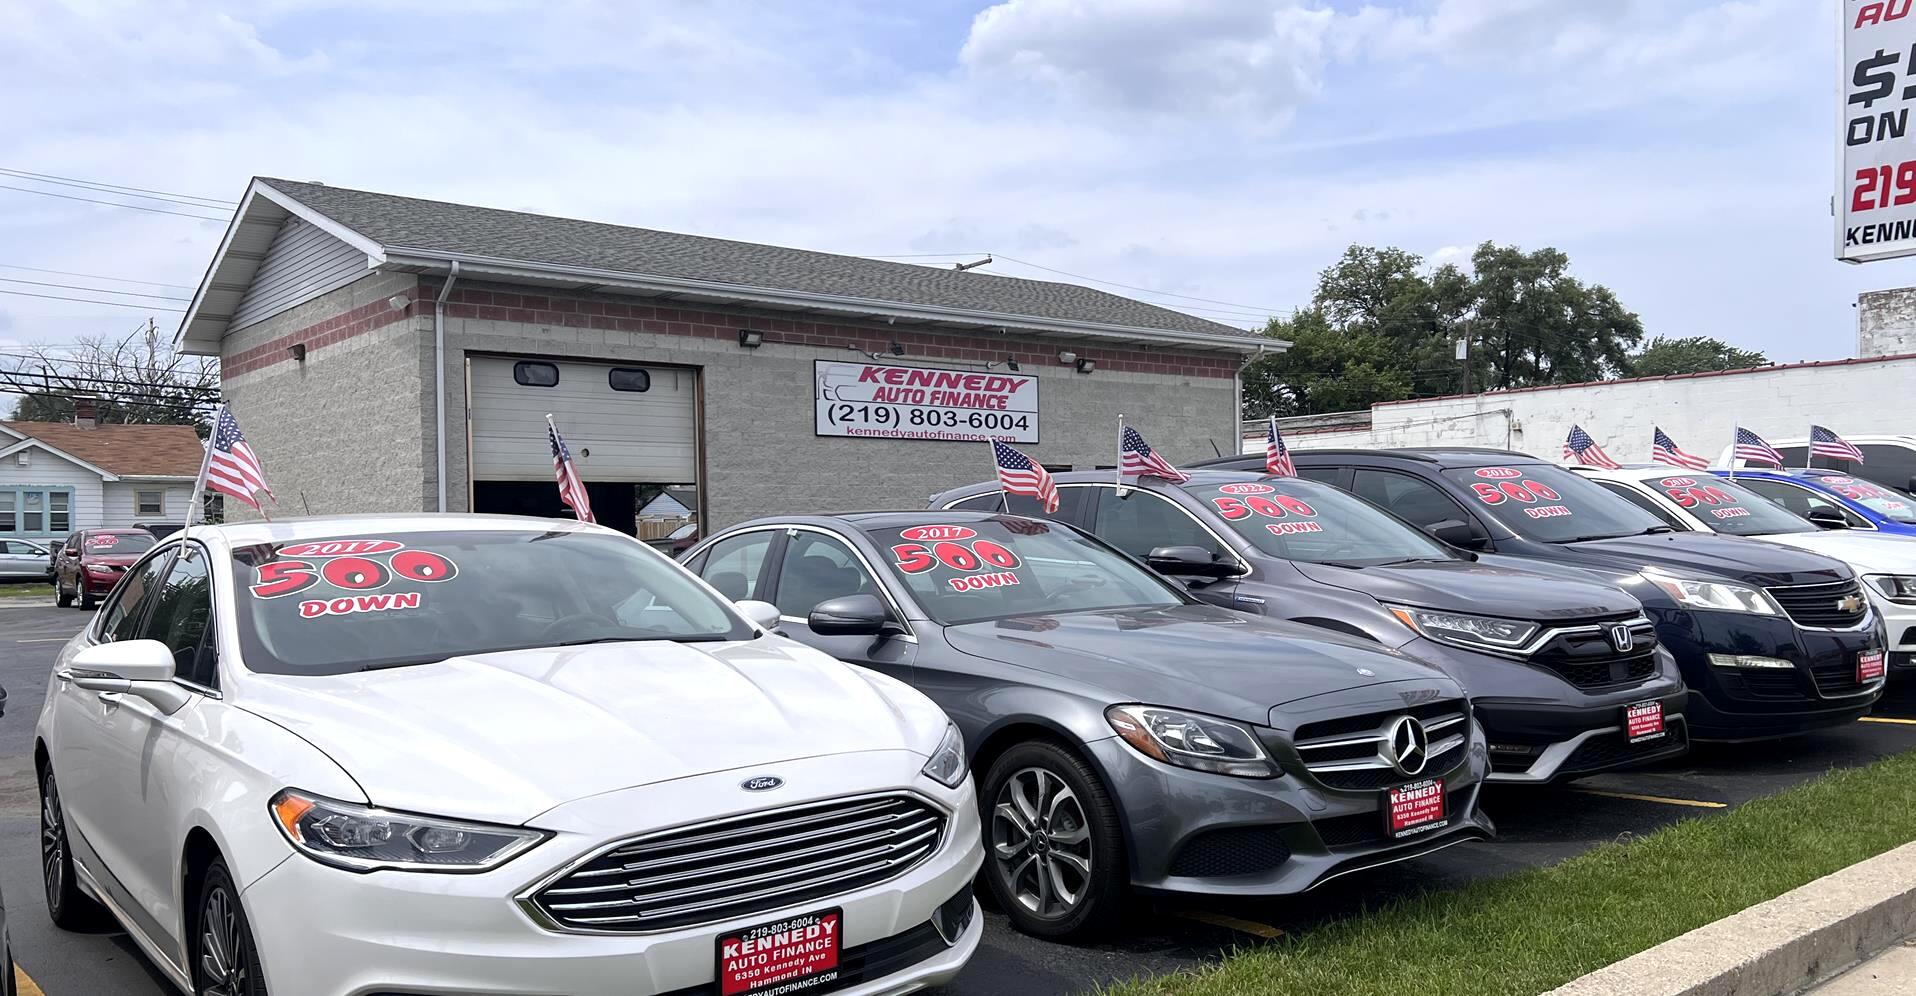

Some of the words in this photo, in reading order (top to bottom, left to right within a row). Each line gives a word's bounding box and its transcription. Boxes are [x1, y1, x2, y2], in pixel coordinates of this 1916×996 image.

[1847, 108, 1909, 146] ON
[1851, 160, 1916, 213] 219
[1845, 219, 1916, 246] KENN
[858, 366, 1029, 394] KENNEDY
[872, 386, 925, 405] AUTO
[929, 389, 1009, 410] FINANCE
[828, 403, 900, 429] (219)
[909, 408, 1029, 431] 803-6004
[1230, 484, 1266, 493] 2022
[1470, 479, 1561, 506] 500
[1665, 485, 1739, 508] 500
[1212, 495, 1318, 521] 500
[1524, 505, 1572, 519] DOWN
[917, 527, 962, 540] 2017
[1266, 521, 1323, 535] DOWN
[301, 541, 382, 556] 2017
[891, 540, 1022, 575] 500
[248, 550, 459, 599] 500
[948, 572, 1020, 592] DOWN
[299, 592, 421, 618] DOWN
[1627, 705, 1661, 718] KENNEDY
[750, 777, 776, 789] Ford
[1391, 784, 1441, 804] KENNEDY
[1393, 803, 1413, 813] AUTO
[1415, 795, 1440, 808] FINANCE
[723, 920, 836, 959] KENNEDY
[750, 916, 813, 939] 219-803-6004
[728, 953, 768, 971] AUTO
[773, 937, 832, 960] FINANCE
[735, 968, 760, 981] 6350
[764, 958, 805, 974] Kennedy
[808, 953, 826, 963] Ave
[750, 969, 798, 989] Hammond
[802, 966, 813, 974] IN
